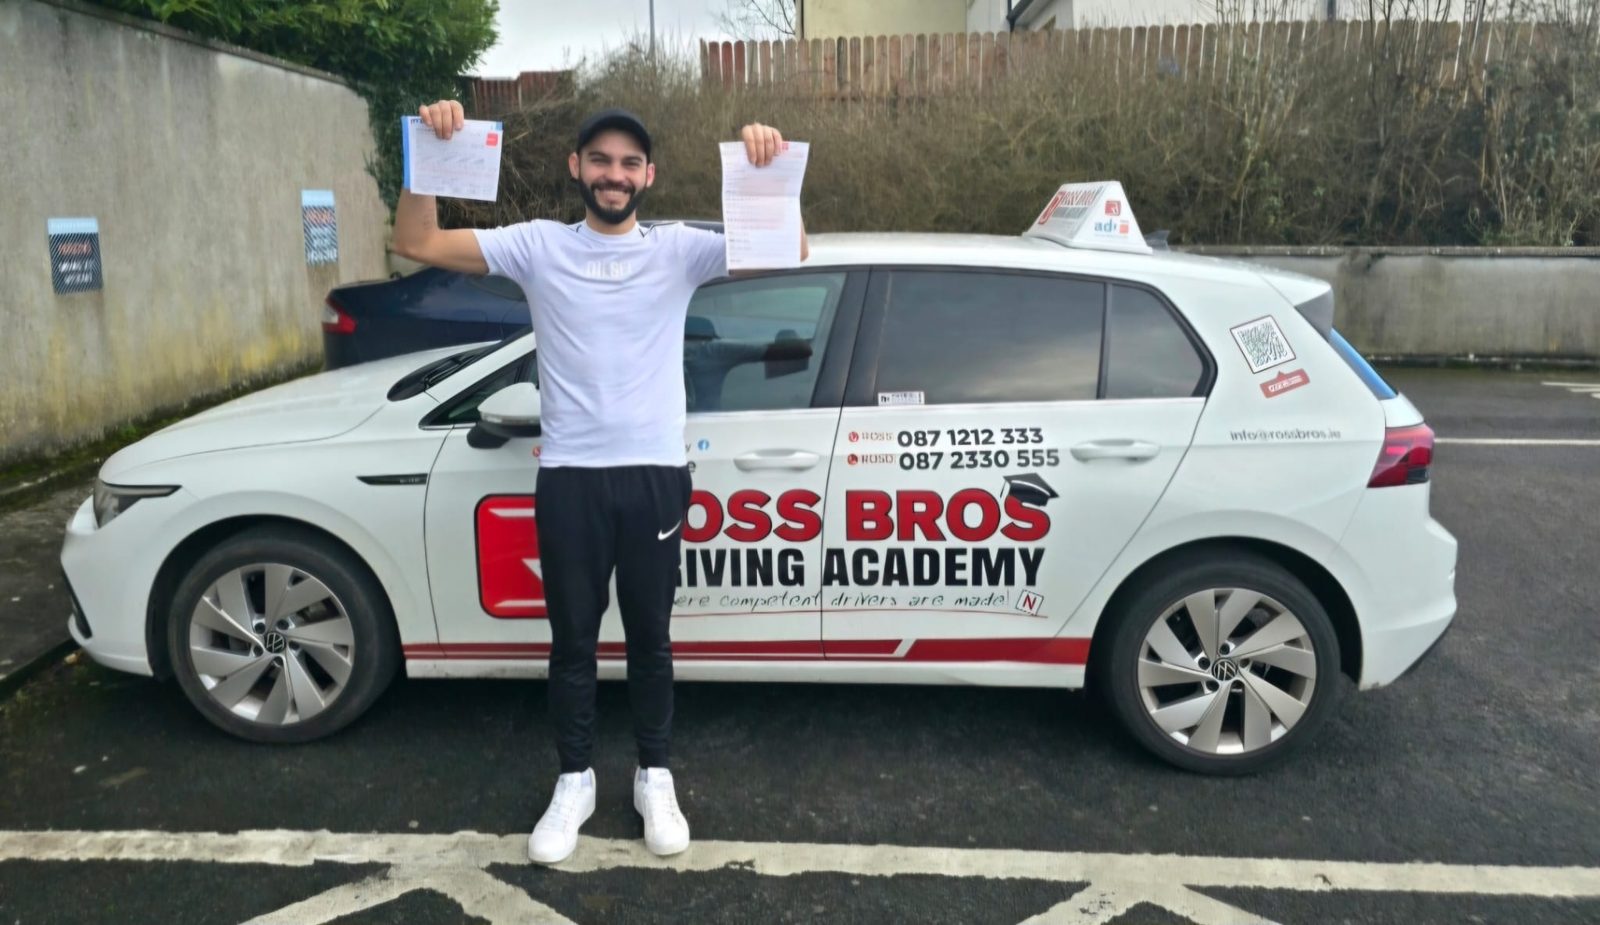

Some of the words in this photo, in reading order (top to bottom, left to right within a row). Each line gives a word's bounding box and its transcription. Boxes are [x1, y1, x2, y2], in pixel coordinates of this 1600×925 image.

[897, 430, 941, 447] 087
[947, 429, 995, 446] 1212
[1000, 428, 1044, 444] 333
[899, 452, 944, 470] 087
[950, 451, 1009, 469] 2330
[1017, 449, 1060, 467] 555
[681, 488, 822, 543] OSS
[845, 488, 1051, 542] BROS
[675, 548, 805, 587] IVING
[822, 547, 1046, 587] ACADEMY
[719, 590, 821, 612] competent
[830, 592, 897, 607] drivers
[908, 595, 944, 606] are
[1023, 593, 1037, 610] N
